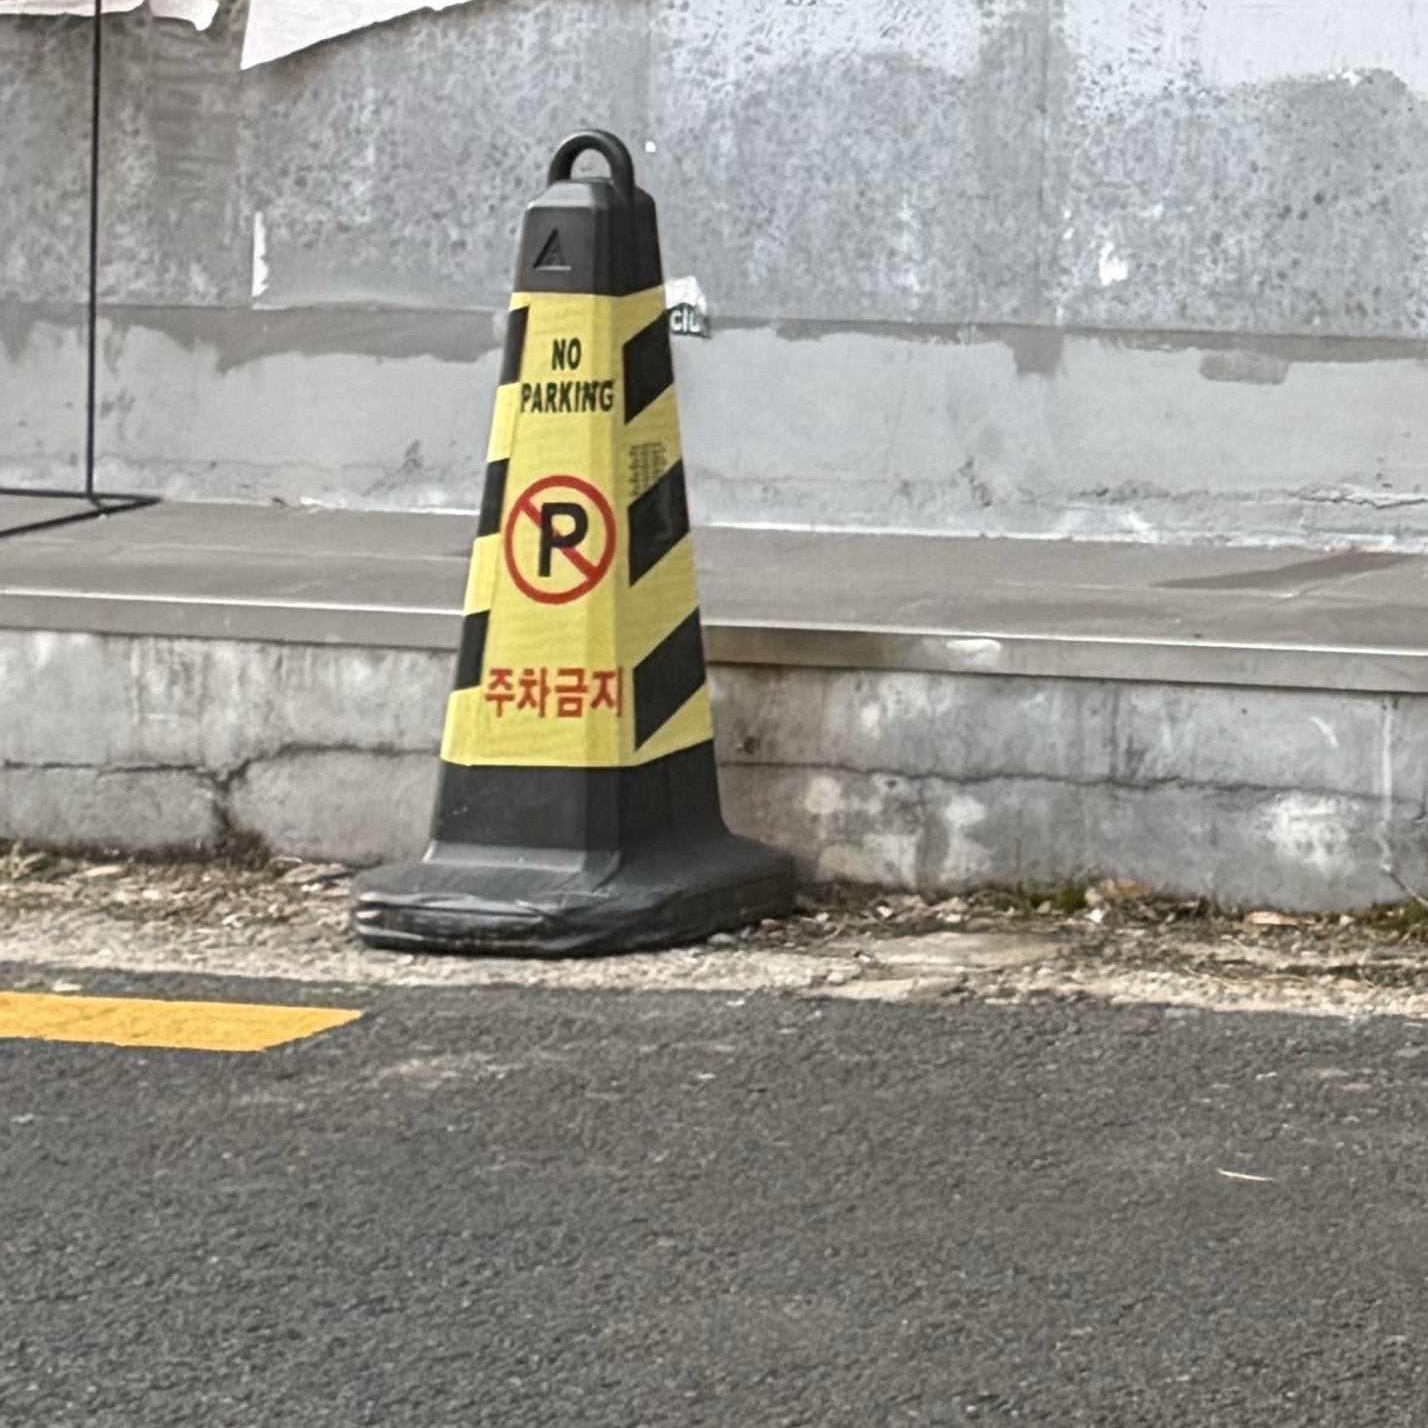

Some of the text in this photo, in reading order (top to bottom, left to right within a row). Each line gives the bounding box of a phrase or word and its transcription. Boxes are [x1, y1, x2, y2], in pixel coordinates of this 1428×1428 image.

[551, 337, 582, 371] NO
[520, 380, 615, 413] PARKING
[485, 667, 624, 718] 주차금지
